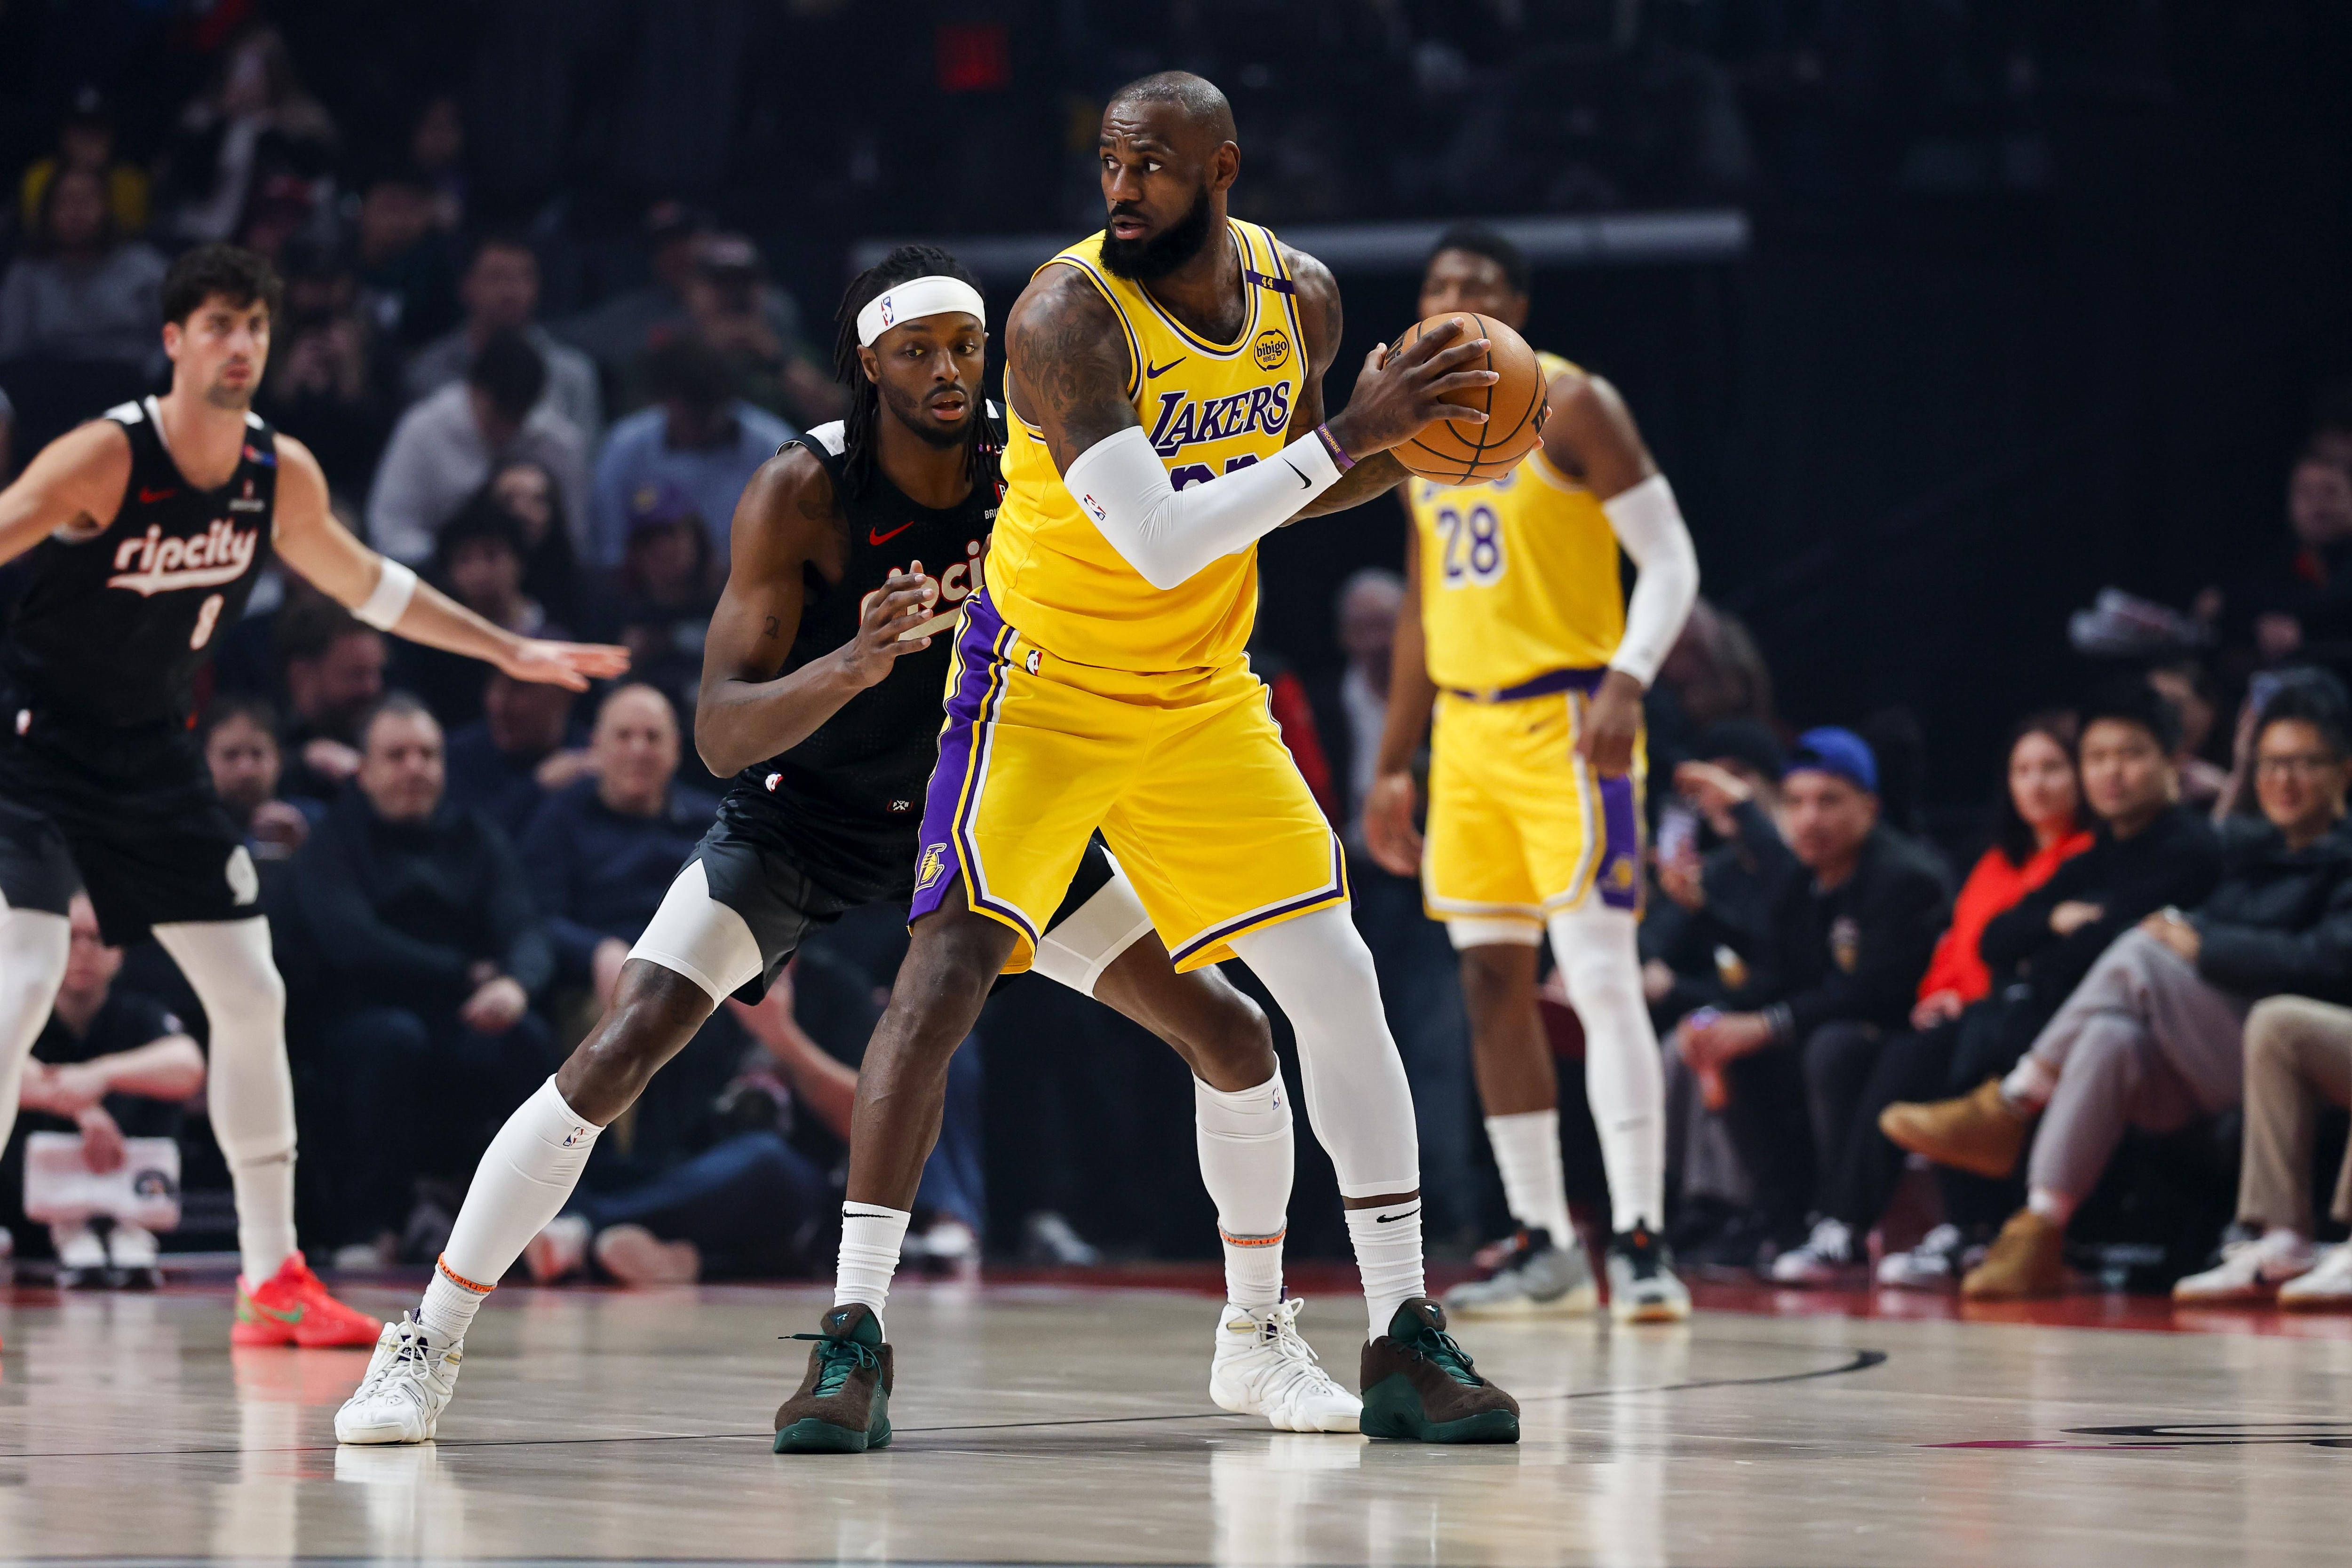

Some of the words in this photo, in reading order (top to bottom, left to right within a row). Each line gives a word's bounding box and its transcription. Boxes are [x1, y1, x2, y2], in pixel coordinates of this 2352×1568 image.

[1262, 277, 1273, 288] 44
[1256, 341, 1287, 357] bibigo
[1148, 380, 1292, 459] LAKERS
[1321, 428, 1341, 454] PROMISE
[107, 517, 258, 598] ripcity
[1436, 503, 1504, 587] 28
